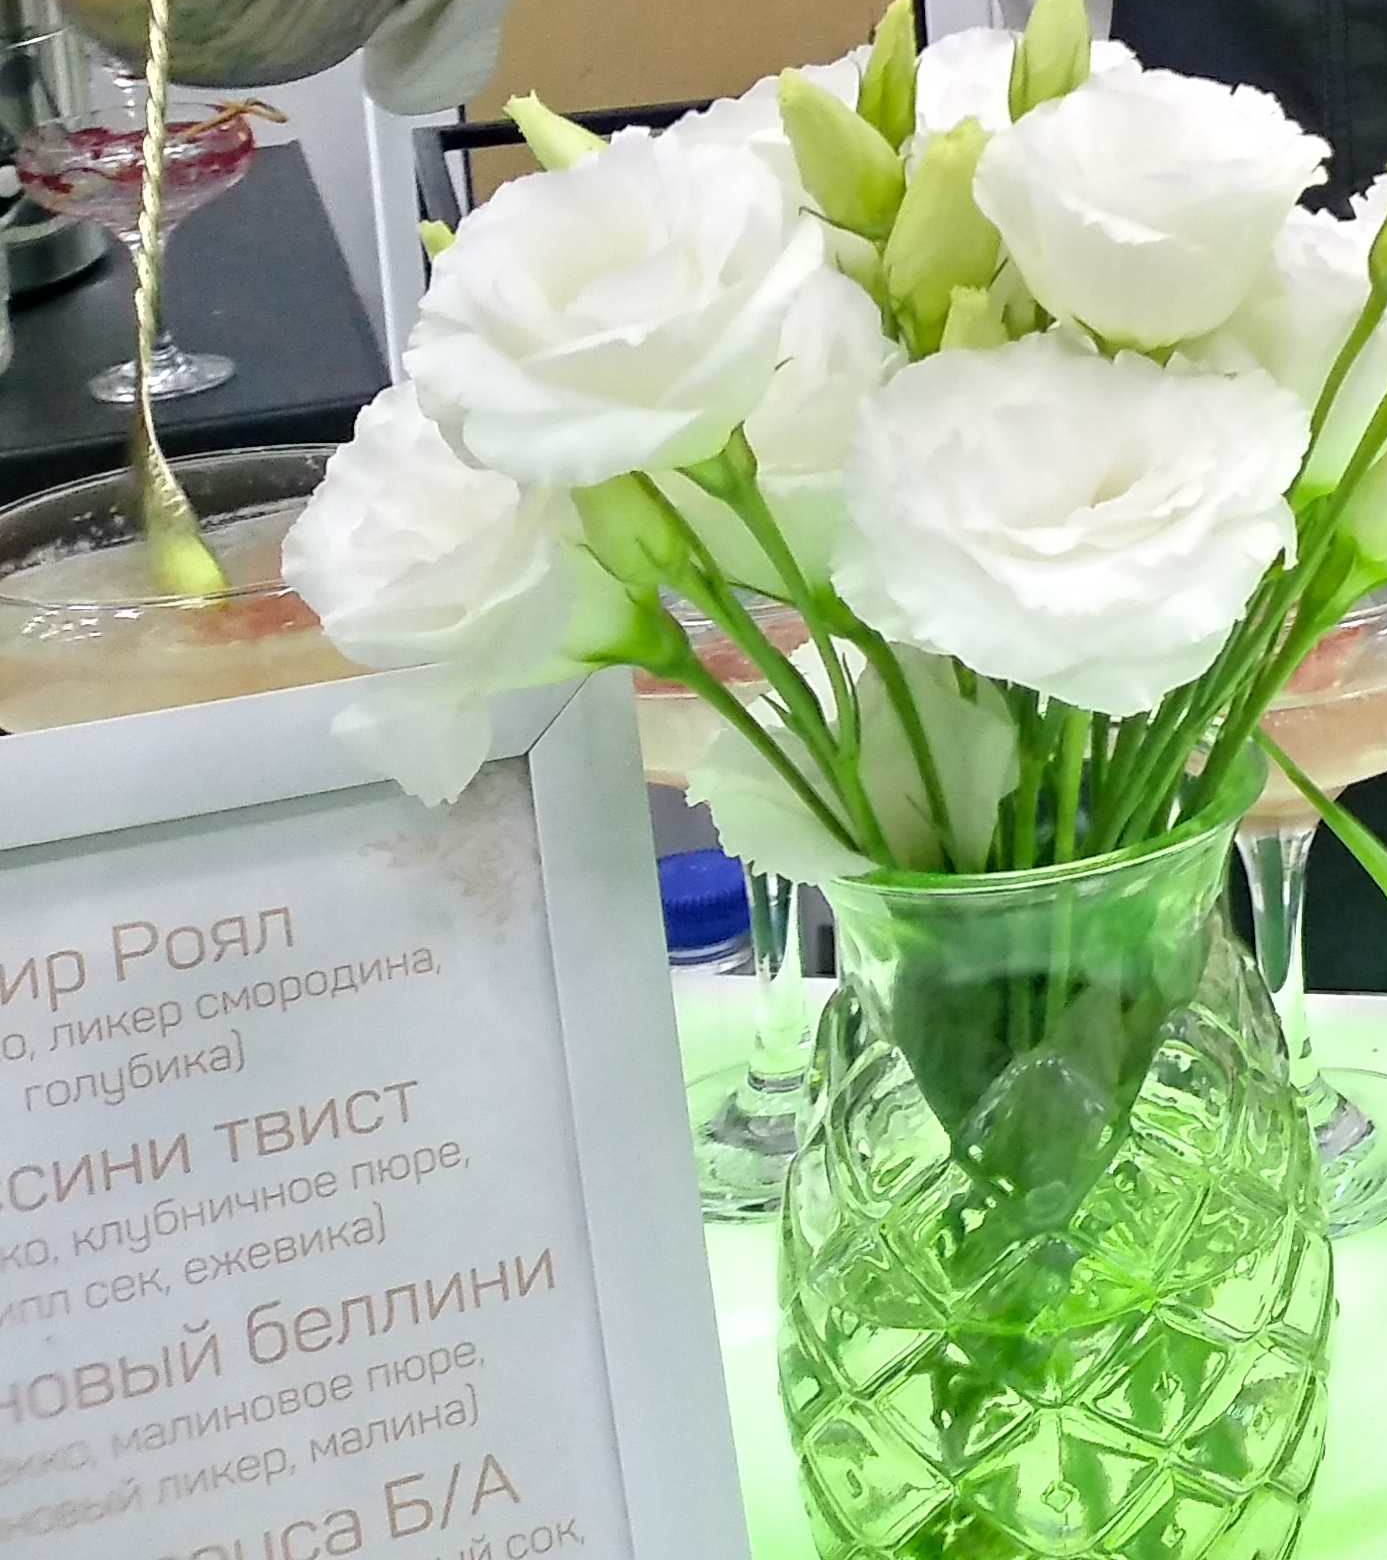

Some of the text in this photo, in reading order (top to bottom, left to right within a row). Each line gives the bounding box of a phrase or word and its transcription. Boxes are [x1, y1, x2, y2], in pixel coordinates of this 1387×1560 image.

[0, 906, 293, 1012] ир Роял
[50, 1001, 182, 1052] ликер
[195, 947, 441, 1019] смородина,
[24, 1028, 245, 1111] голубика)
[0, 1080, 418, 1212] сини твист
[72, 1170, 338, 1256] клубничное
[351, 1141, 470, 1192] пюре,
[84, 1268, 171, 1309] сек,
[184, 1201, 386, 1285] ежевика)
[246, 1248, 555, 1364] беллини
[110, 1374, 353, 1458] малиновое
[366, 1341, 485, 1392] пюре,
[156, 1447, 297, 1506] ликер,
[309, 1383, 478, 1464] малина)
[384, 1453, 521, 1538] Б/А
[506, 1518, 585, 1560] сок,
